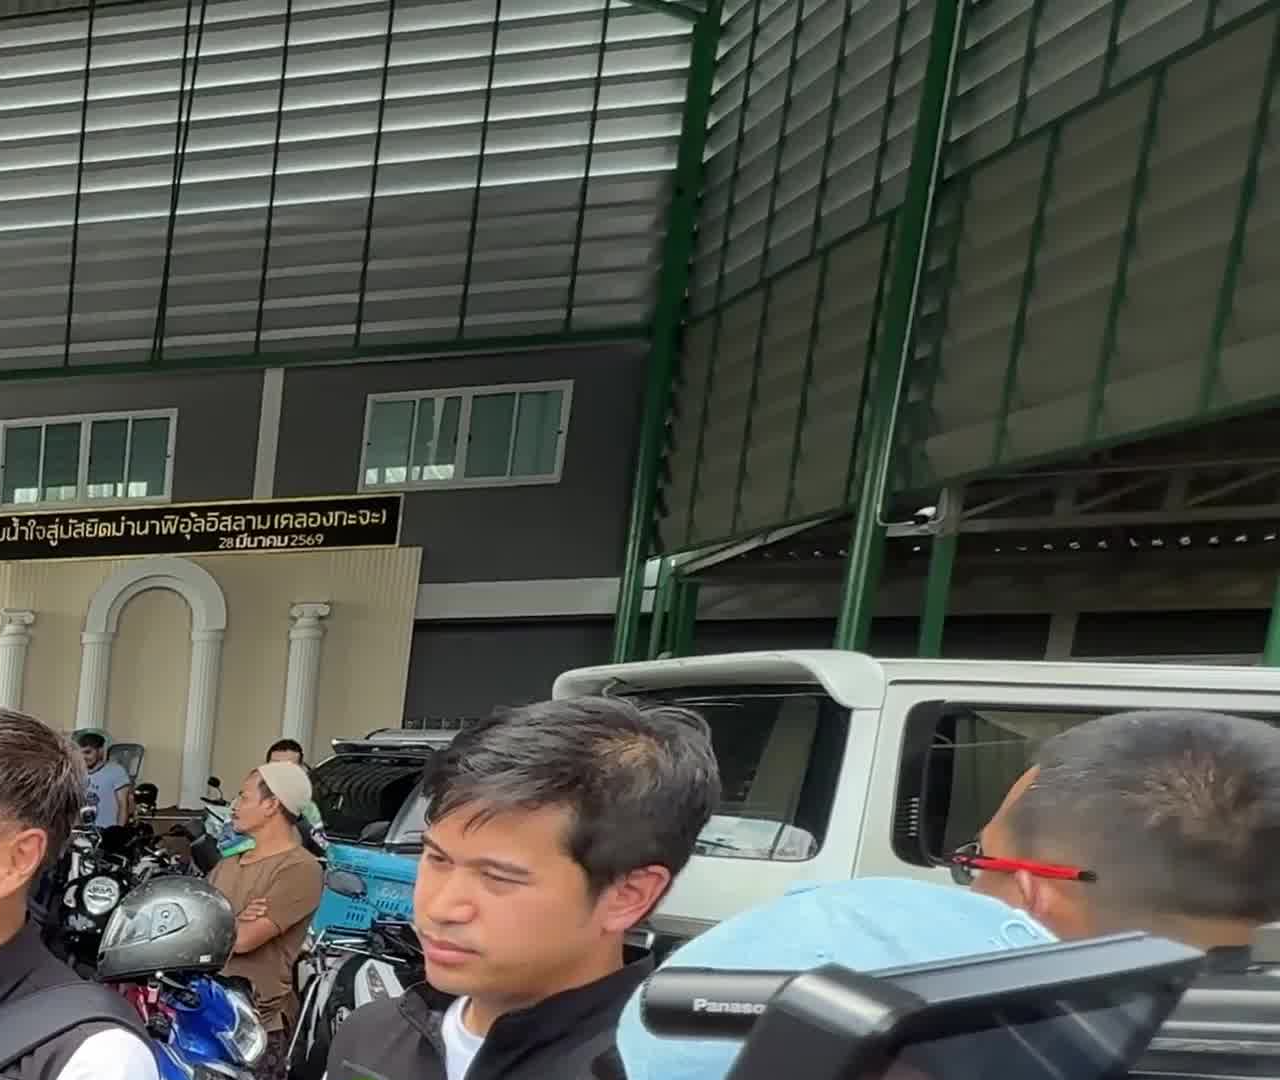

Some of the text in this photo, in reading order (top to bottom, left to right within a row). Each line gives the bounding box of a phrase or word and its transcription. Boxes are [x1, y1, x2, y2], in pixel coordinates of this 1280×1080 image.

[218, 533, 324, 549] 28 มีนาคม 2569
[692, 998, 768, 1014] Panaso
